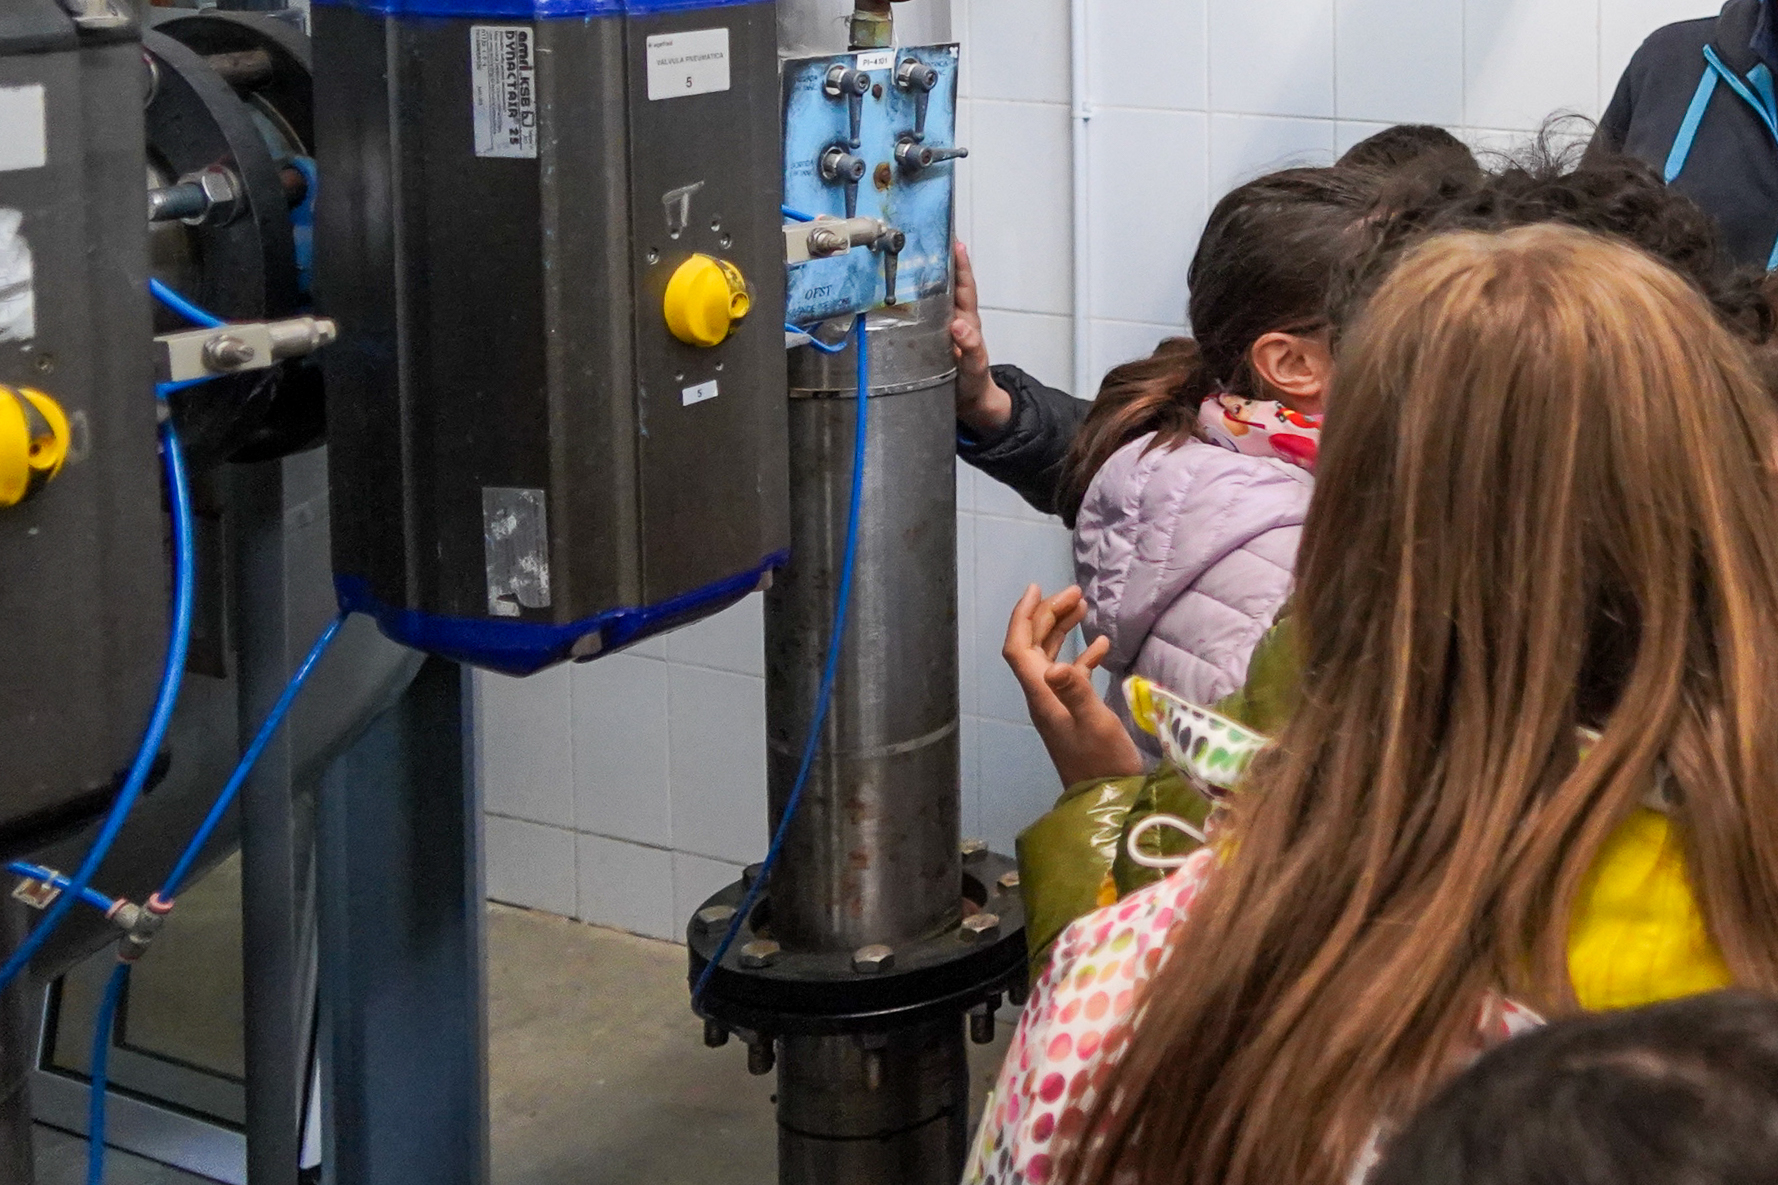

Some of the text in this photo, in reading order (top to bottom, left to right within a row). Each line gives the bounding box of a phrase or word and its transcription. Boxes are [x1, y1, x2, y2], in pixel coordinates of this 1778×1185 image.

[505, 30, 520, 145] DYNACTAIR 25
[520, 77, 530, 107] KSB
[686, 76, 692, 88] 5
